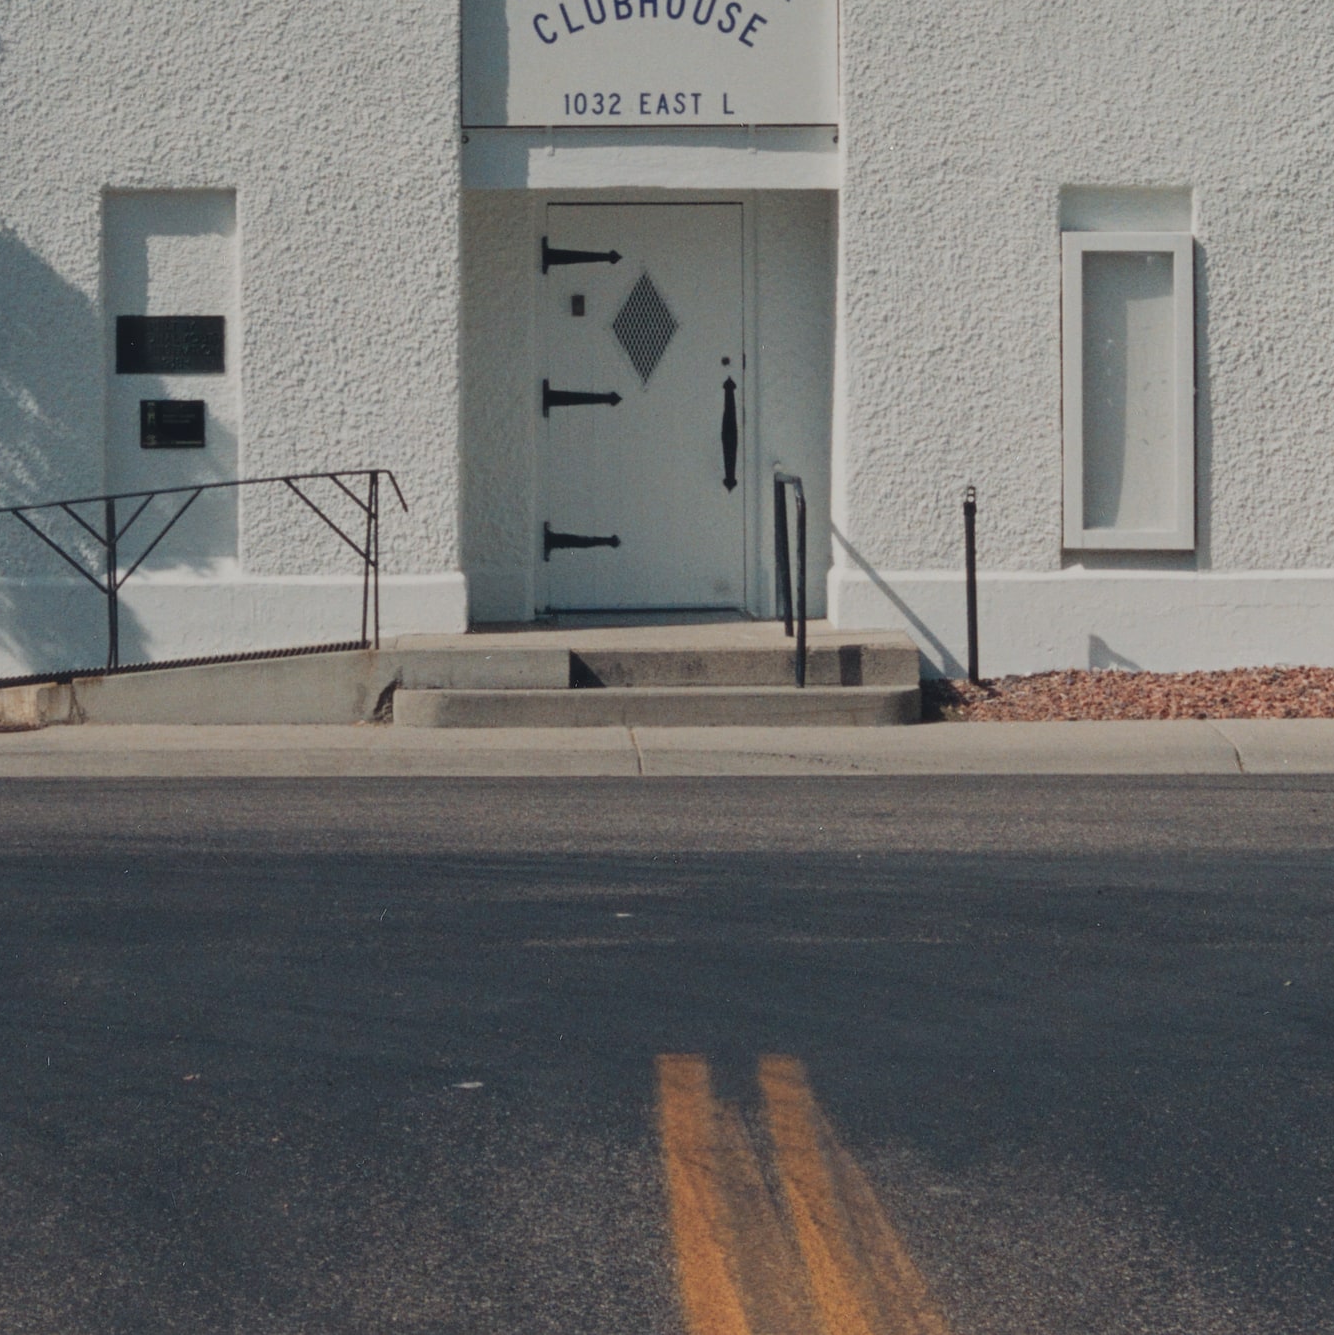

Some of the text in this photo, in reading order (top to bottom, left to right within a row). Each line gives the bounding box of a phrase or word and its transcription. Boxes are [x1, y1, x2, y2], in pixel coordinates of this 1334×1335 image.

[564, 92, 735, 115] 1032 EAST L
